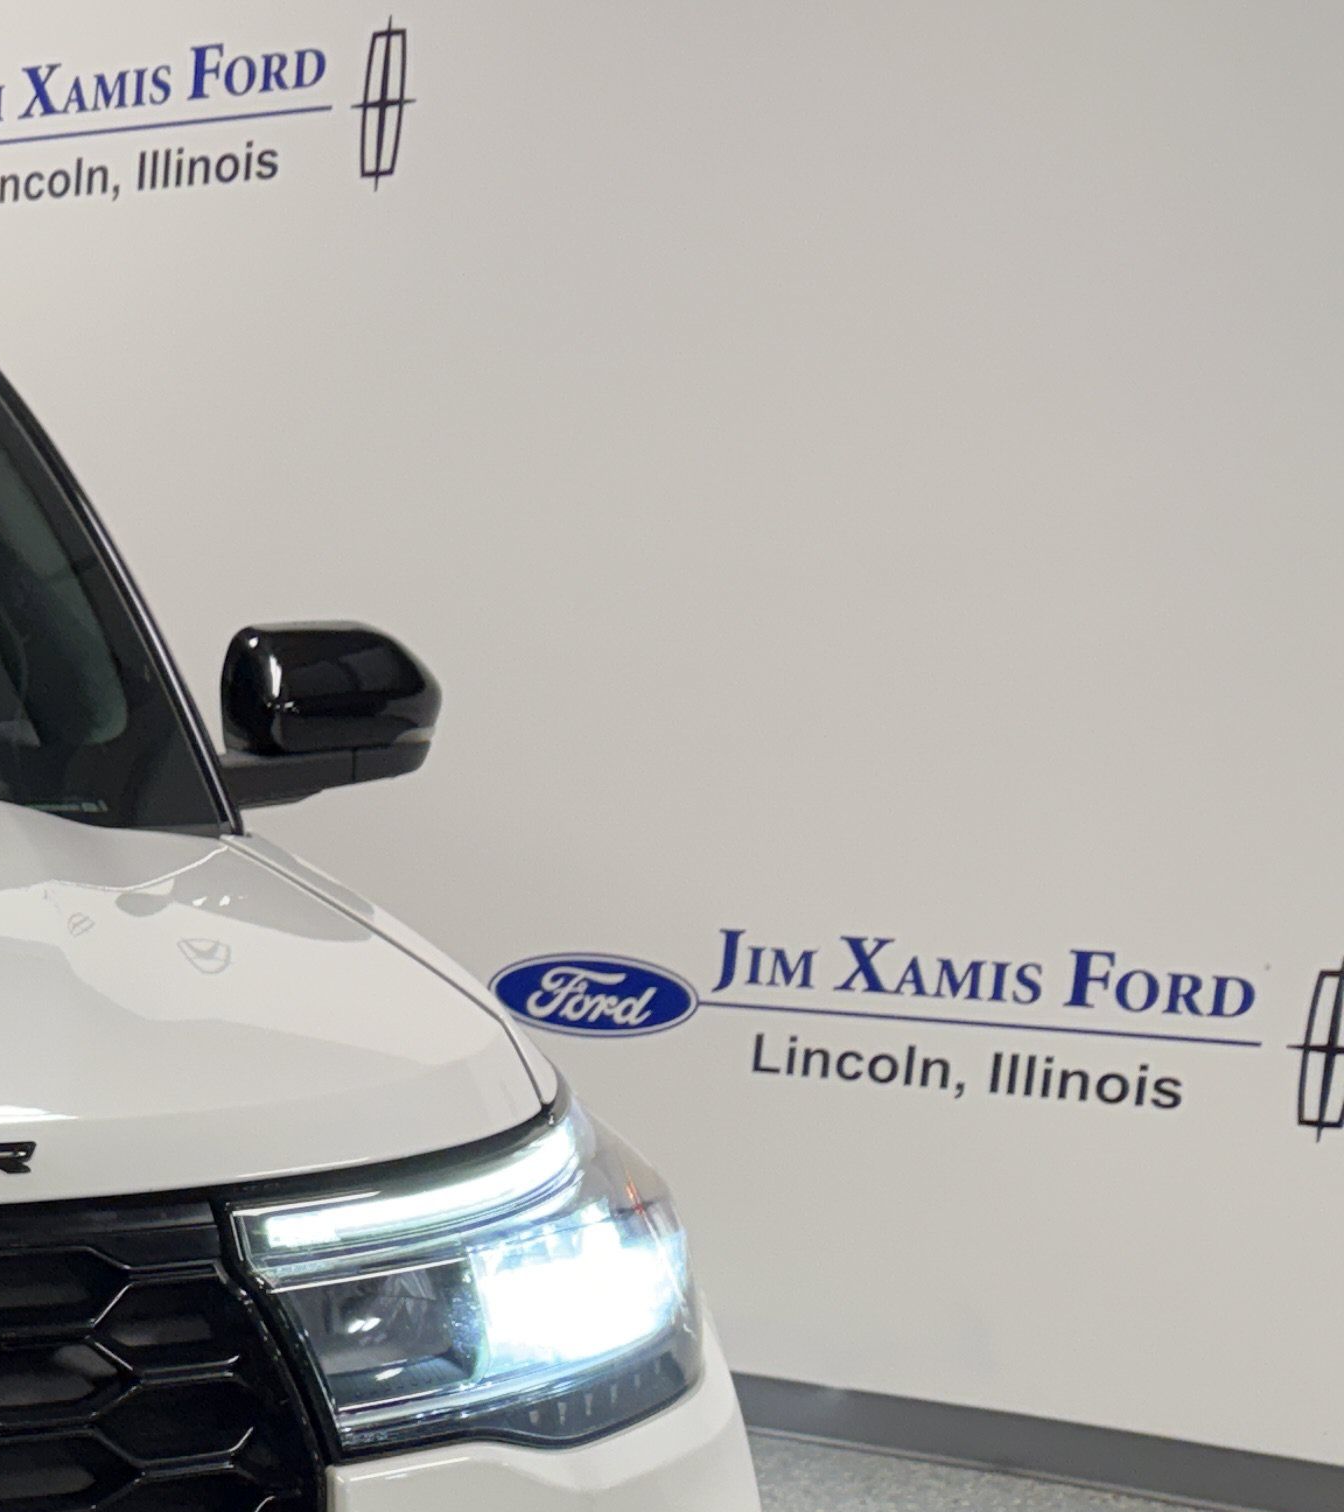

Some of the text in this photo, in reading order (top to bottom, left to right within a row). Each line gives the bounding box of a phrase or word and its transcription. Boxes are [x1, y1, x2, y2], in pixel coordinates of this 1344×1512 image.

[18, 63, 172, 119] XAMIS
[187, 42, 327, 102] FORD
[137, 142, 279, 194] Illinois
[527, 966, 655, 1028] Ford
[712, 928, 1257, 1020] JIM XAMIS FORD
[751, 1033, 1184, 1110] Lincoln, Illinois
